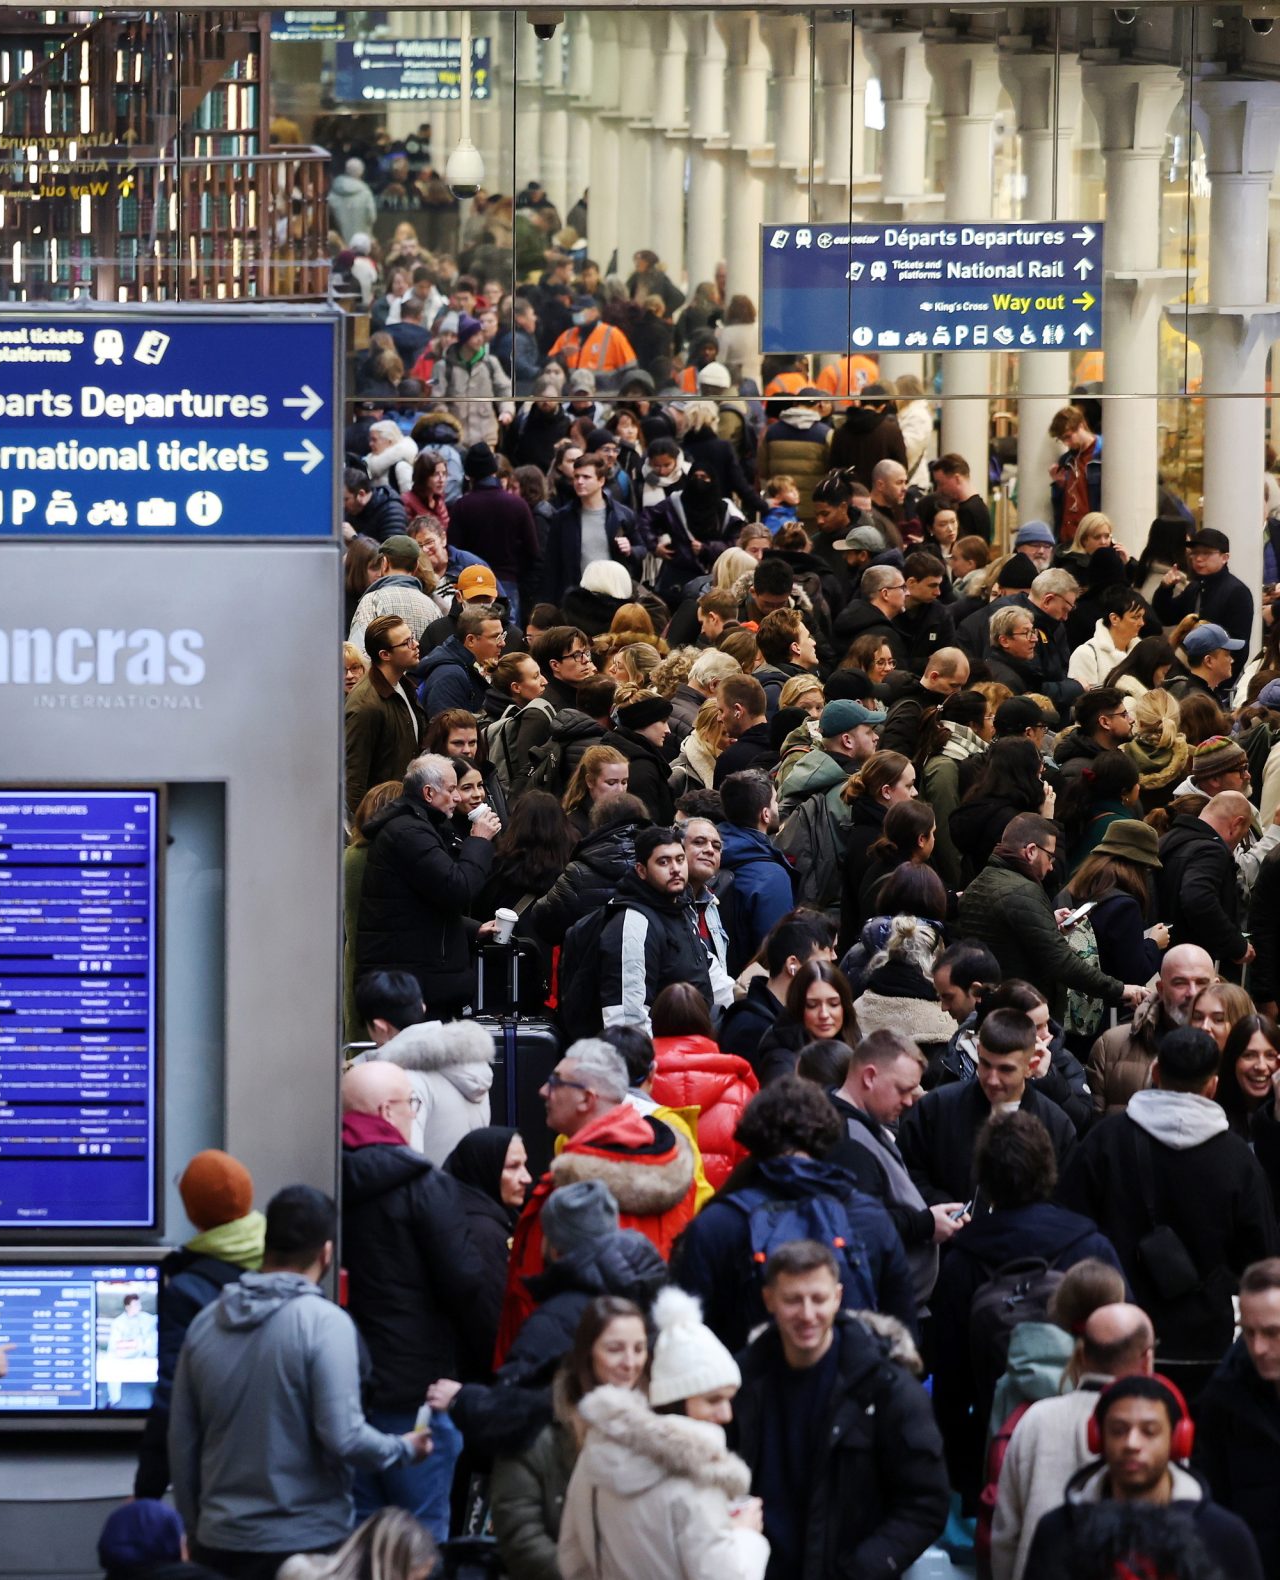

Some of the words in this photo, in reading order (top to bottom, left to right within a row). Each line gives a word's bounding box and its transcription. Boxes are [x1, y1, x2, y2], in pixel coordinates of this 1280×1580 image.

[833, 234, 880, 245] eurostar
[884, 228, 957, 250] Départs
[961, 229, 1065, 250] Departures
[891, 260, 922, 270] Tickets
[923, 259, 942, 269] and
[947, 261, 1024, 279] National
[1028, 261, 1065, 278] Rail
[898, 270, 942, 281] platforms
[963, 302, 989, 312] Cross
[992, 294, 1032, 314] Way
[1034, 294, 1065, 311] out
[28, 327, 84, 344] tickets
[81, 386, 269, 425] Departures
[156, 439, 269, 472] tickets
[33, 694, 204, 710] INTERNATIONAL
